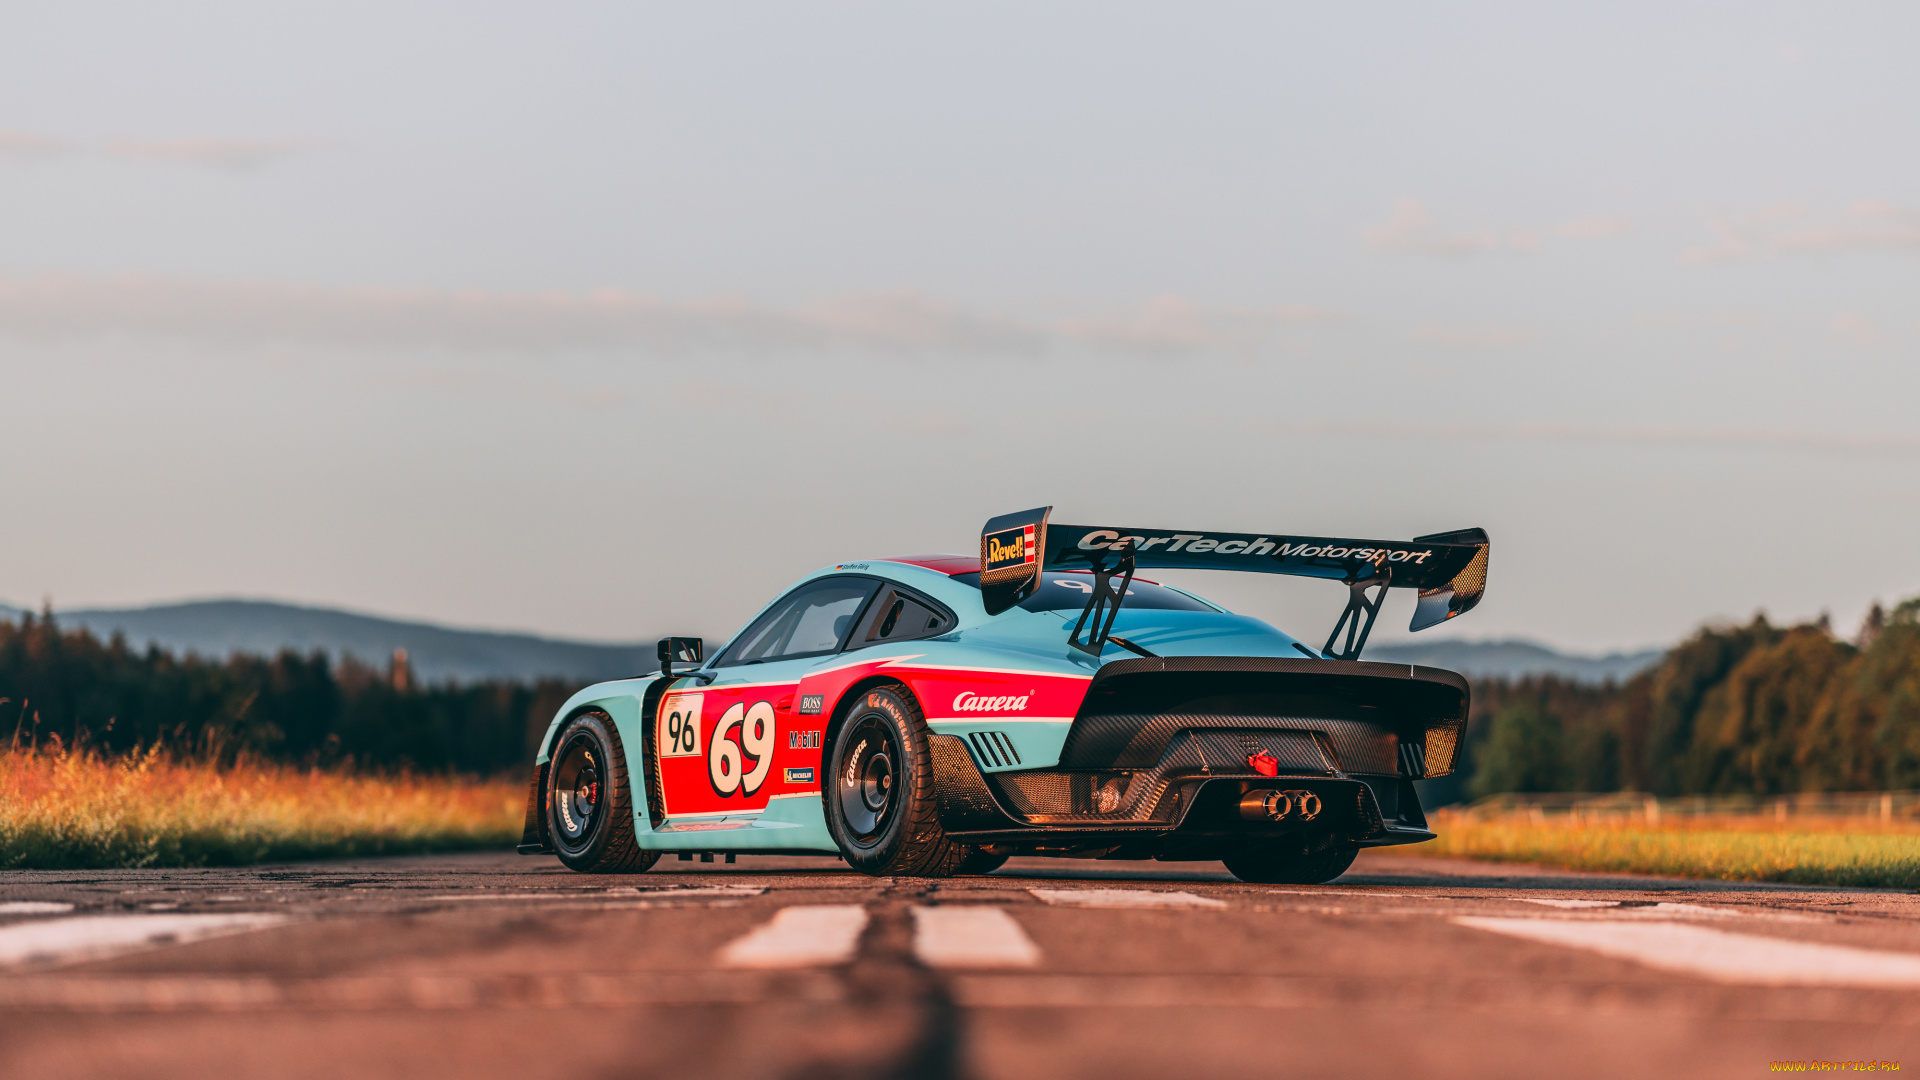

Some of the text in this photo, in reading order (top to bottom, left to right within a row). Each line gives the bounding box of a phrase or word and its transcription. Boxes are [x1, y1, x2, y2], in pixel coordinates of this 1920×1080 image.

[989, 536, 1024, 563] Revell
[1077, 530, 1432, 564] CarTech Motorsport
[802, 696, 820, 709] BOSS
[668, 711, 695, 753] 96
[789, 730, 813, 749] Mobil
[881, 698, 912, 752] MICHELIN
[709, 701, 776, 798] 69
[846, 738, 867, 788] Carrera
